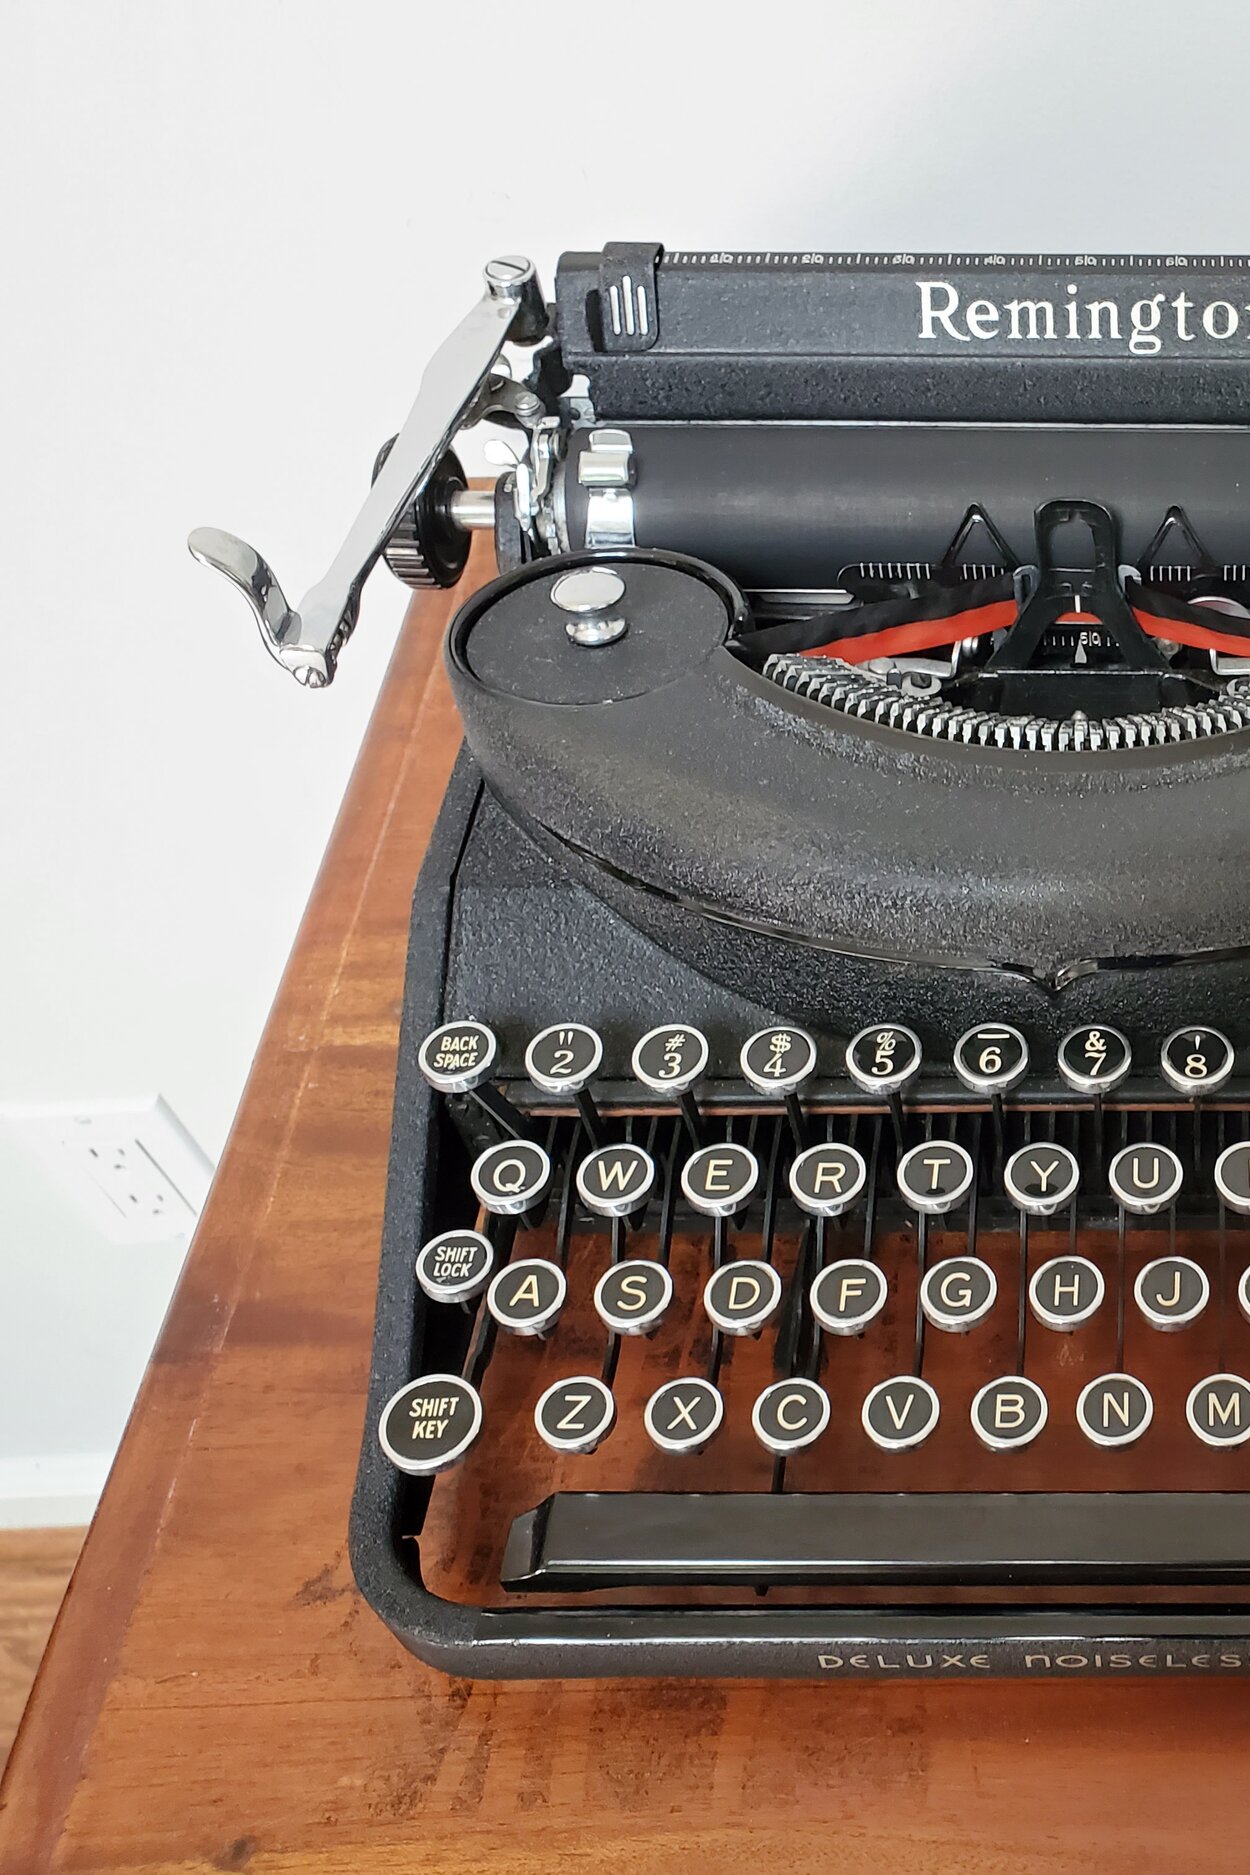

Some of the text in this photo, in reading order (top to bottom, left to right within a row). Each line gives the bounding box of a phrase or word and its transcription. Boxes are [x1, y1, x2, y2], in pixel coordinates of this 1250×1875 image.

[440, 1035, 480, 1052] BACK
[665, 1033, 686, 1052] #
[769, 1032, 792, 1054] $
[1083, 1030, 1107, 1051] &
[433, 1051, 479, 1070] SPACE
[549, 1049, 574, 1075] 2
[658, 1052, 684, 1080] 3
[763, 1052, 787, 1078] 4
[871, 1050, 895, 1077] 5
[978, 1046, 1002, 1074] 6
[1083, 1052, 1107, 1076] 7
[1184, 1054, 1208, 1079] 8
[493, 1159, 527, 1193] Q
[598, 1160, 641, 1193] W
[704, 1159, 733, 1191] E
[814, 1162, 849, 1196] R
[923, 1158, 951, 1190] T
[1030, 1160, 1062, 1194] Y
[1132, 1157, 1159, 1189] U
[432, 1244, 478, 1263] SHIFT
[432, 1262, 473, 1279] LOCK
[508, 1274, 541, 1308] A
[616, 1275, 648, 1311] S
[728, 1276, 763, 1313] D
[839, 1278, 869, 1313] F
[940, 1272, 972, 1308] G
[1053, 1274, 1080, 1307] H
[1156, 1271, 1181, 1307] J
[408, 1396, 460, 1418] SHIFT
[556, 1395, 592, 1430] Z
[667, 1396, 701, 1430] X
[776, 1394, 808, 1430] C
[885, 1393, 915, 1430] V
[994, 1393, 1026, 1428] B
[1102, 1391, 1129, 1428] N
[1208, 1392, 1240, 1427] M
[411, 1419, 449, 1440] KEY
[817, 1654, 992, 1670] DELUXE
